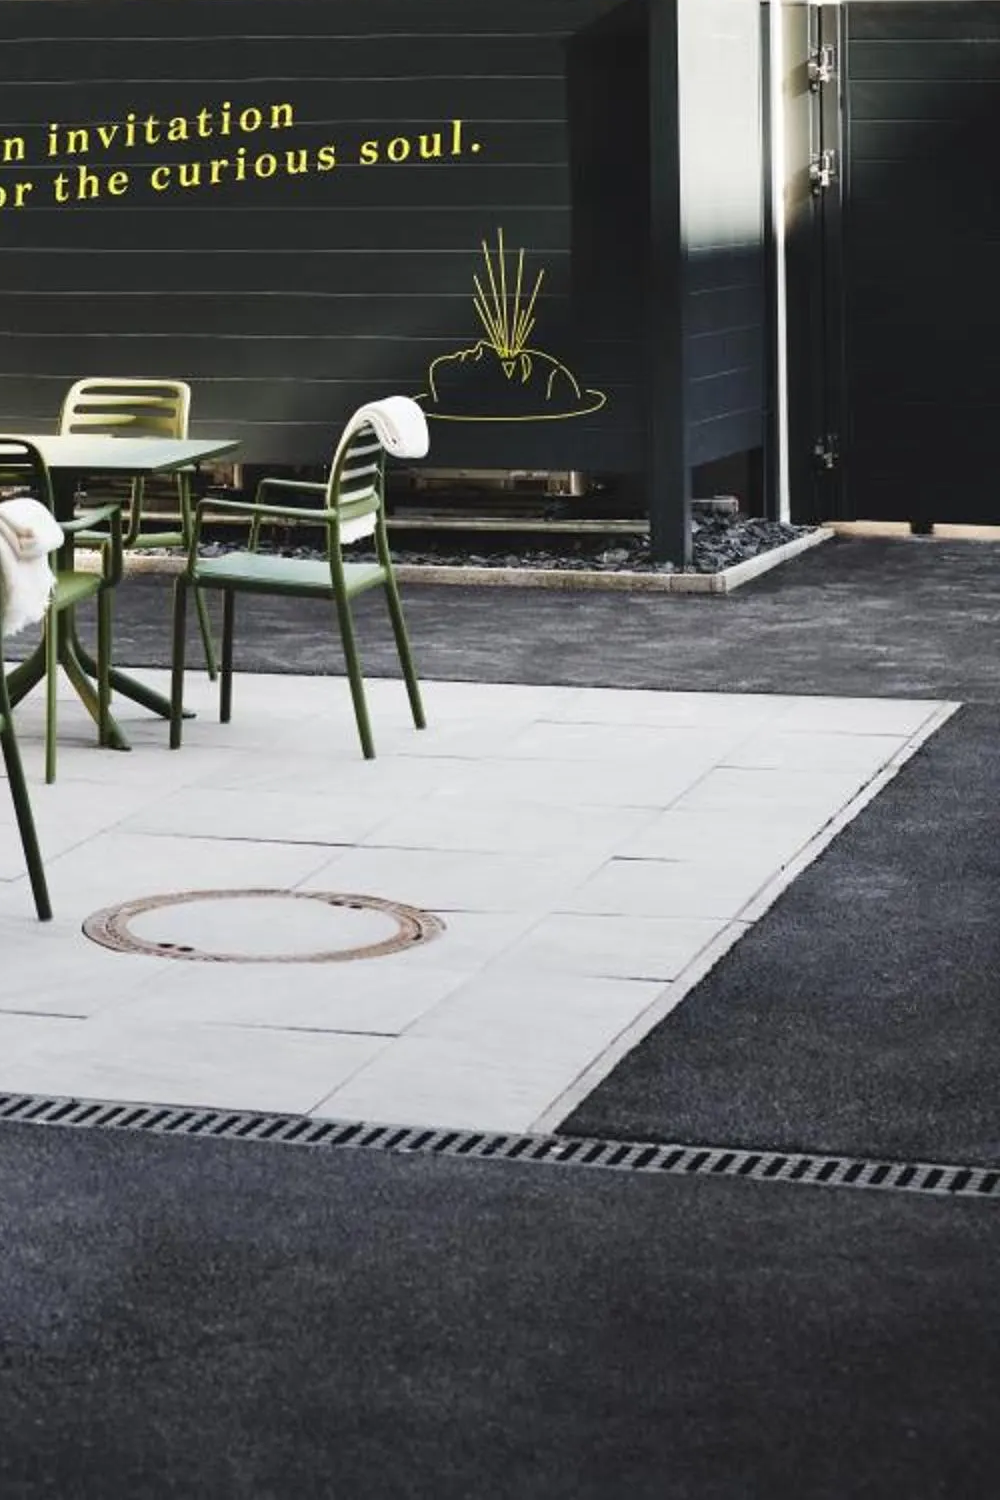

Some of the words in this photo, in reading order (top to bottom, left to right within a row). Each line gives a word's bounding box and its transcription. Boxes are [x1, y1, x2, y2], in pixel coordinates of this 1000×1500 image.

[47, 101, 295, 157] invitation
[53, 163, 129, 203] the
[150, 146, 339, 192] curious
[359, 118, 483, 165] soul.
